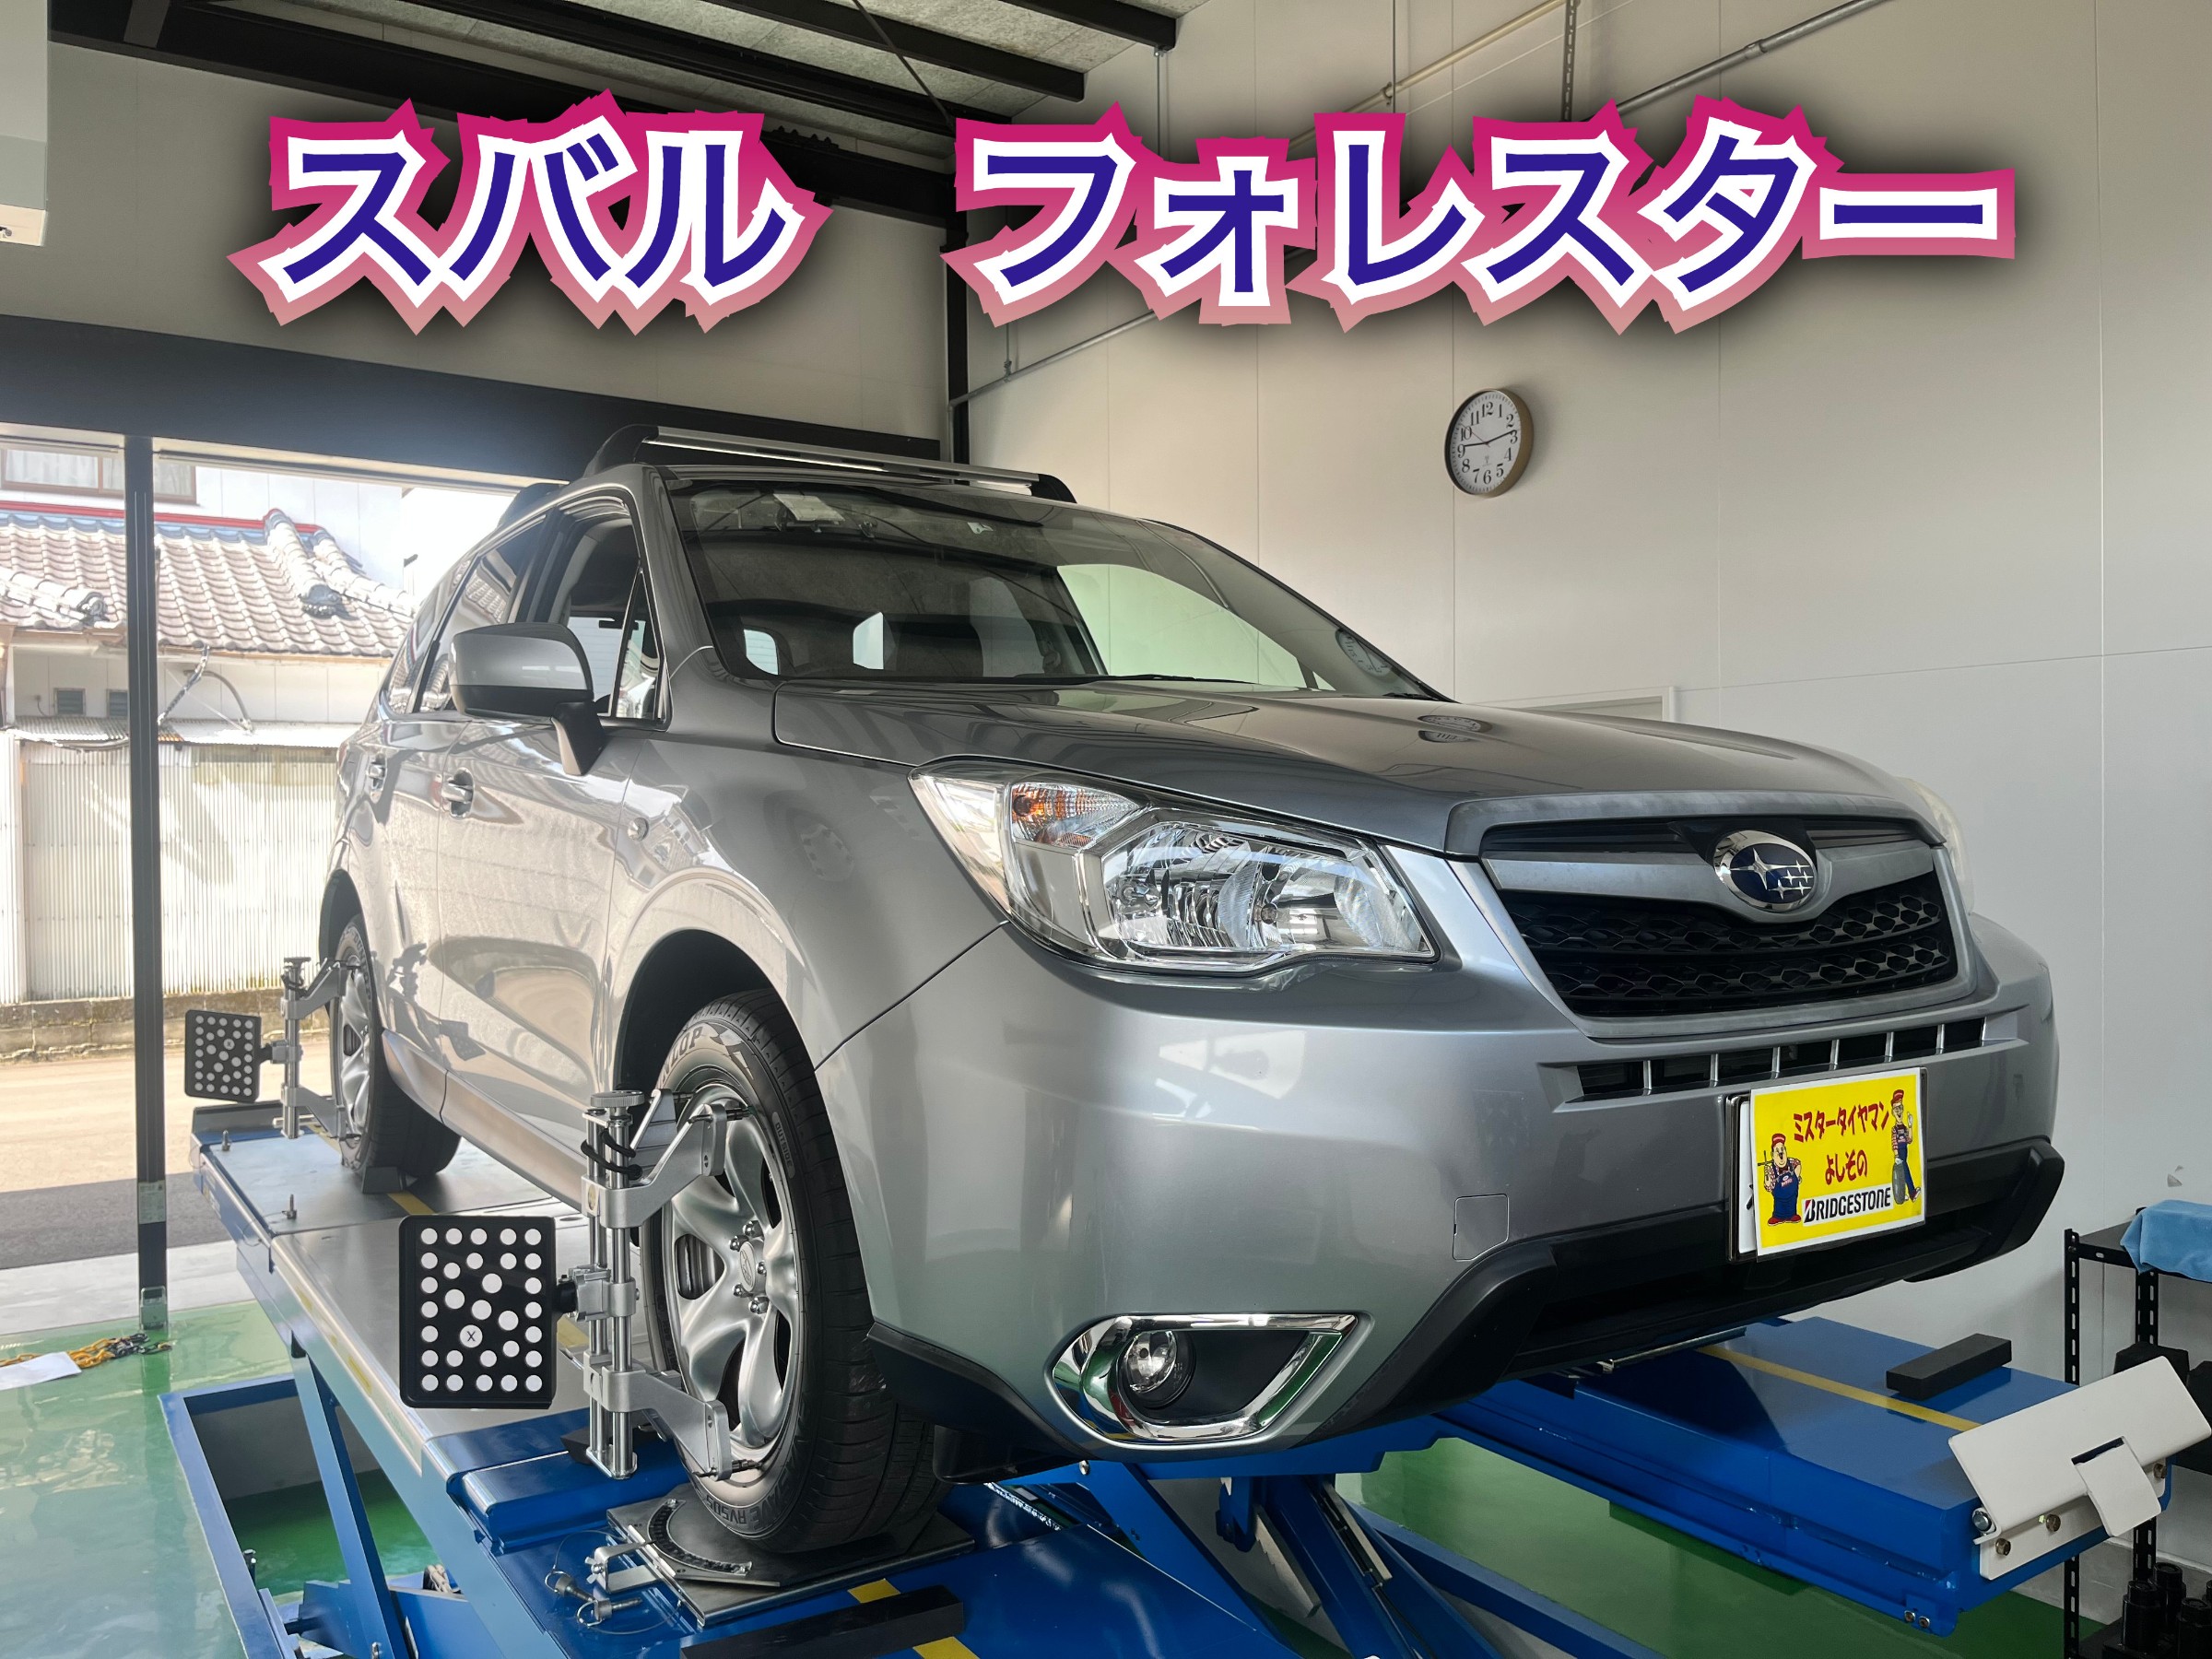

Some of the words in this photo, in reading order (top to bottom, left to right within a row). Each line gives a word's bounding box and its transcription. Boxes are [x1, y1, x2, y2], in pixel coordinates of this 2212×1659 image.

[1482, 402, 1493, 418] 12
[1471, 410, 1479, 426] 11
[1506, 414, 1513, 429] 2
[1461, 426, 1472, 441] 10
[1510, 429, 1518, 444] 3
[1457, 443, 1465, 458] 9
[1504, 447, 1512, 461] 4
[1462, 459, 1470, 473] 8
[1496, 463, 1504, 477] 5
[1473, 468, 1480, 483] 7
[1483, 470, 1491, 484] 6
[1793, 1101, 1889, 1143] ミスタータイヤマン
[1825, 1149, 1867, 1185] よしその
[1804, 1187, 1891, 1223] BRIDGESTONE
[467, 1331, 476, 1342] X
